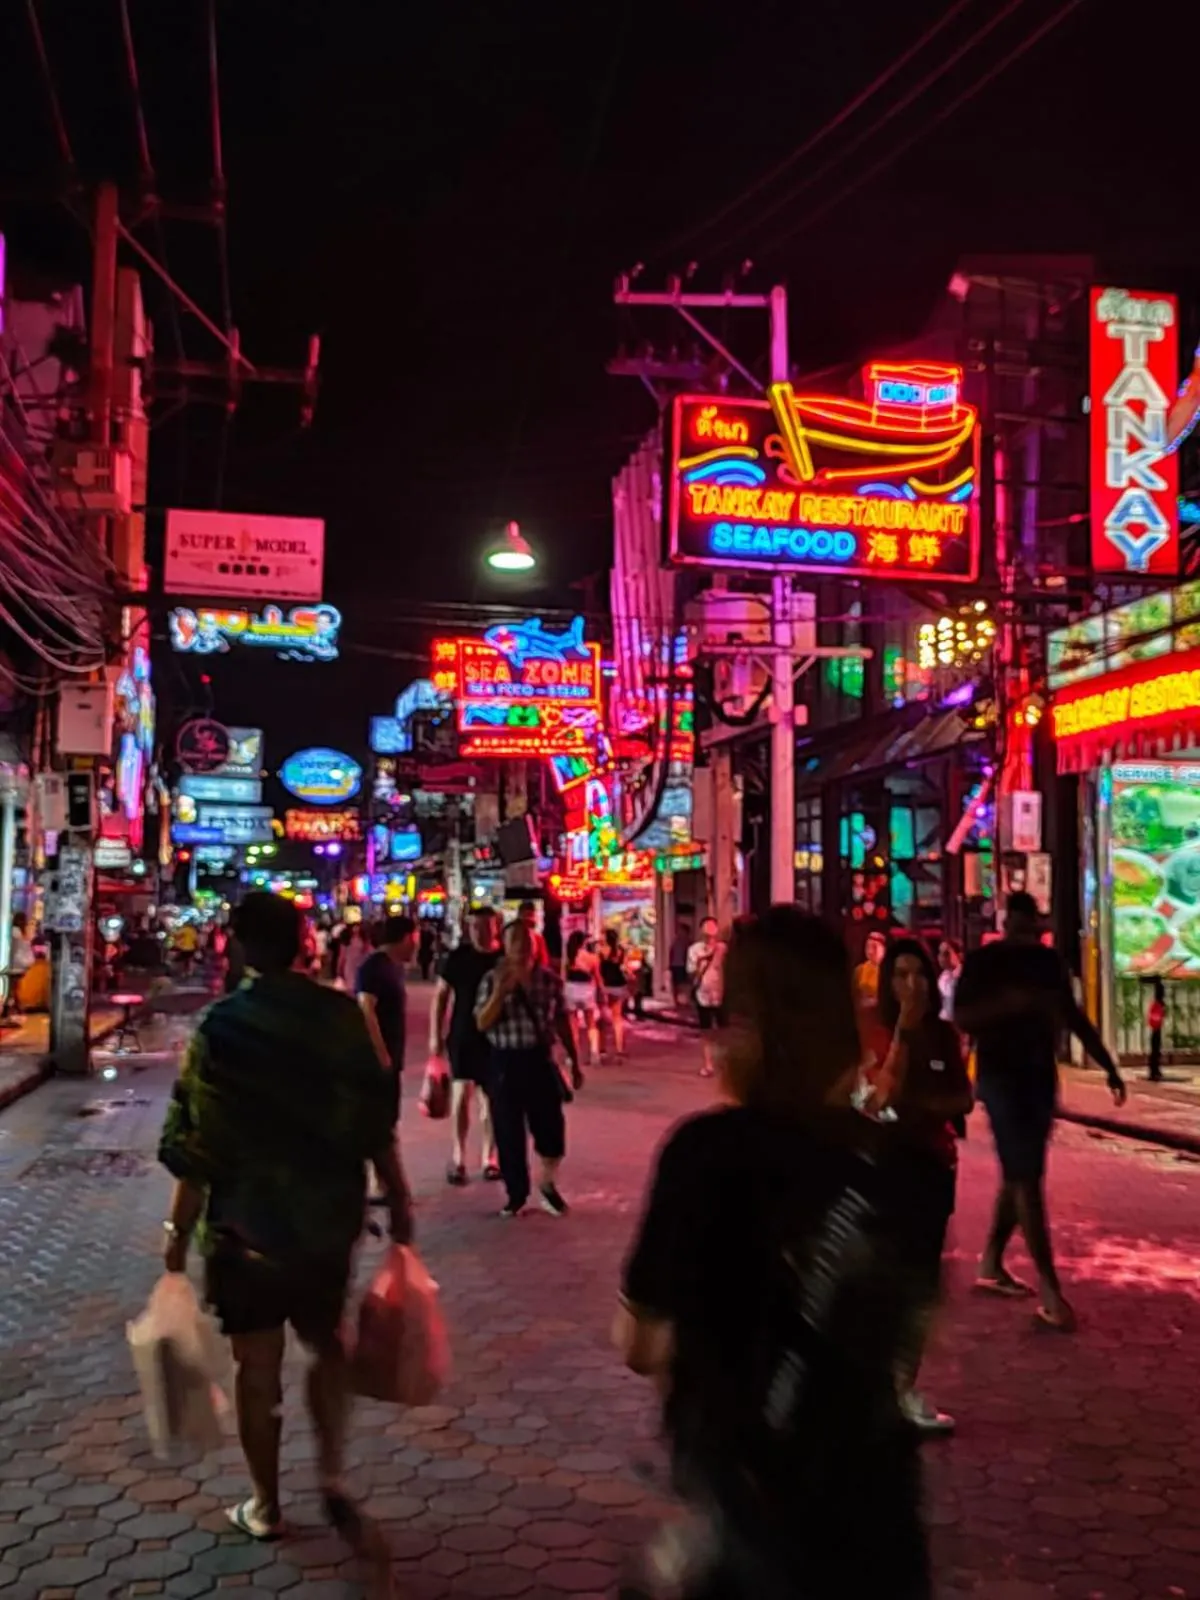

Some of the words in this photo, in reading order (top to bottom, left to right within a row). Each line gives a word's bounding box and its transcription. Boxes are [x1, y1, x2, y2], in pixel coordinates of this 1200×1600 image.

[1103, 323, 1170, 572] TANKAY
[688, 483, 796, 522] TANKAY
[799, 492, 968, 534] RESTAURANT
[179, 533, 236, 550] SUPER
[255, 538, 311, 555] MODEL
[712, 522, 857, 561] SEAFOOD
[464, 661, 512, 683] SEA
[524, 661, 593, 686] ZONE
[1052, 686, 1130, 738] TANKAY
